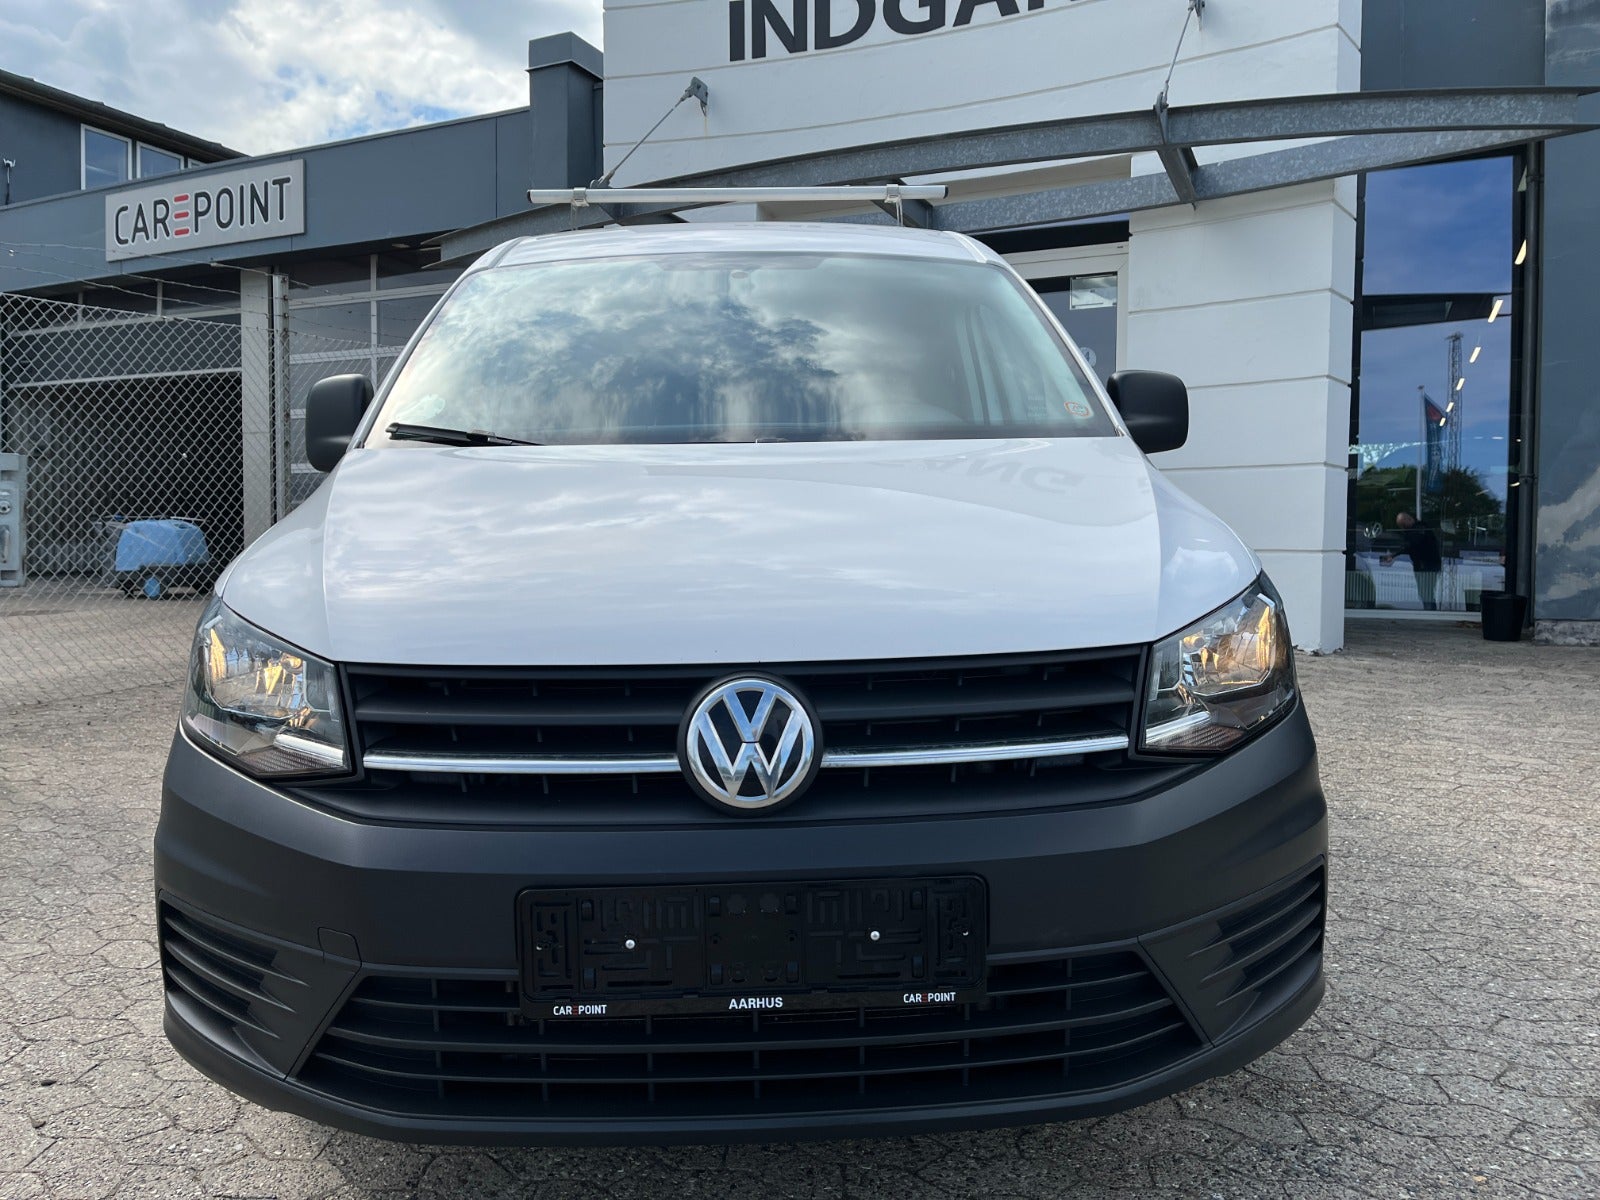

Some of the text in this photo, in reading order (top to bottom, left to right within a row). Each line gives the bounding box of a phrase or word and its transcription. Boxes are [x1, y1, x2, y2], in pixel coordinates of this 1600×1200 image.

[729, 0, 1079, 62] INDG
[115, 177, 292, 245] CAREPOINT
[728, 996, 783, 1010] AARHUS
